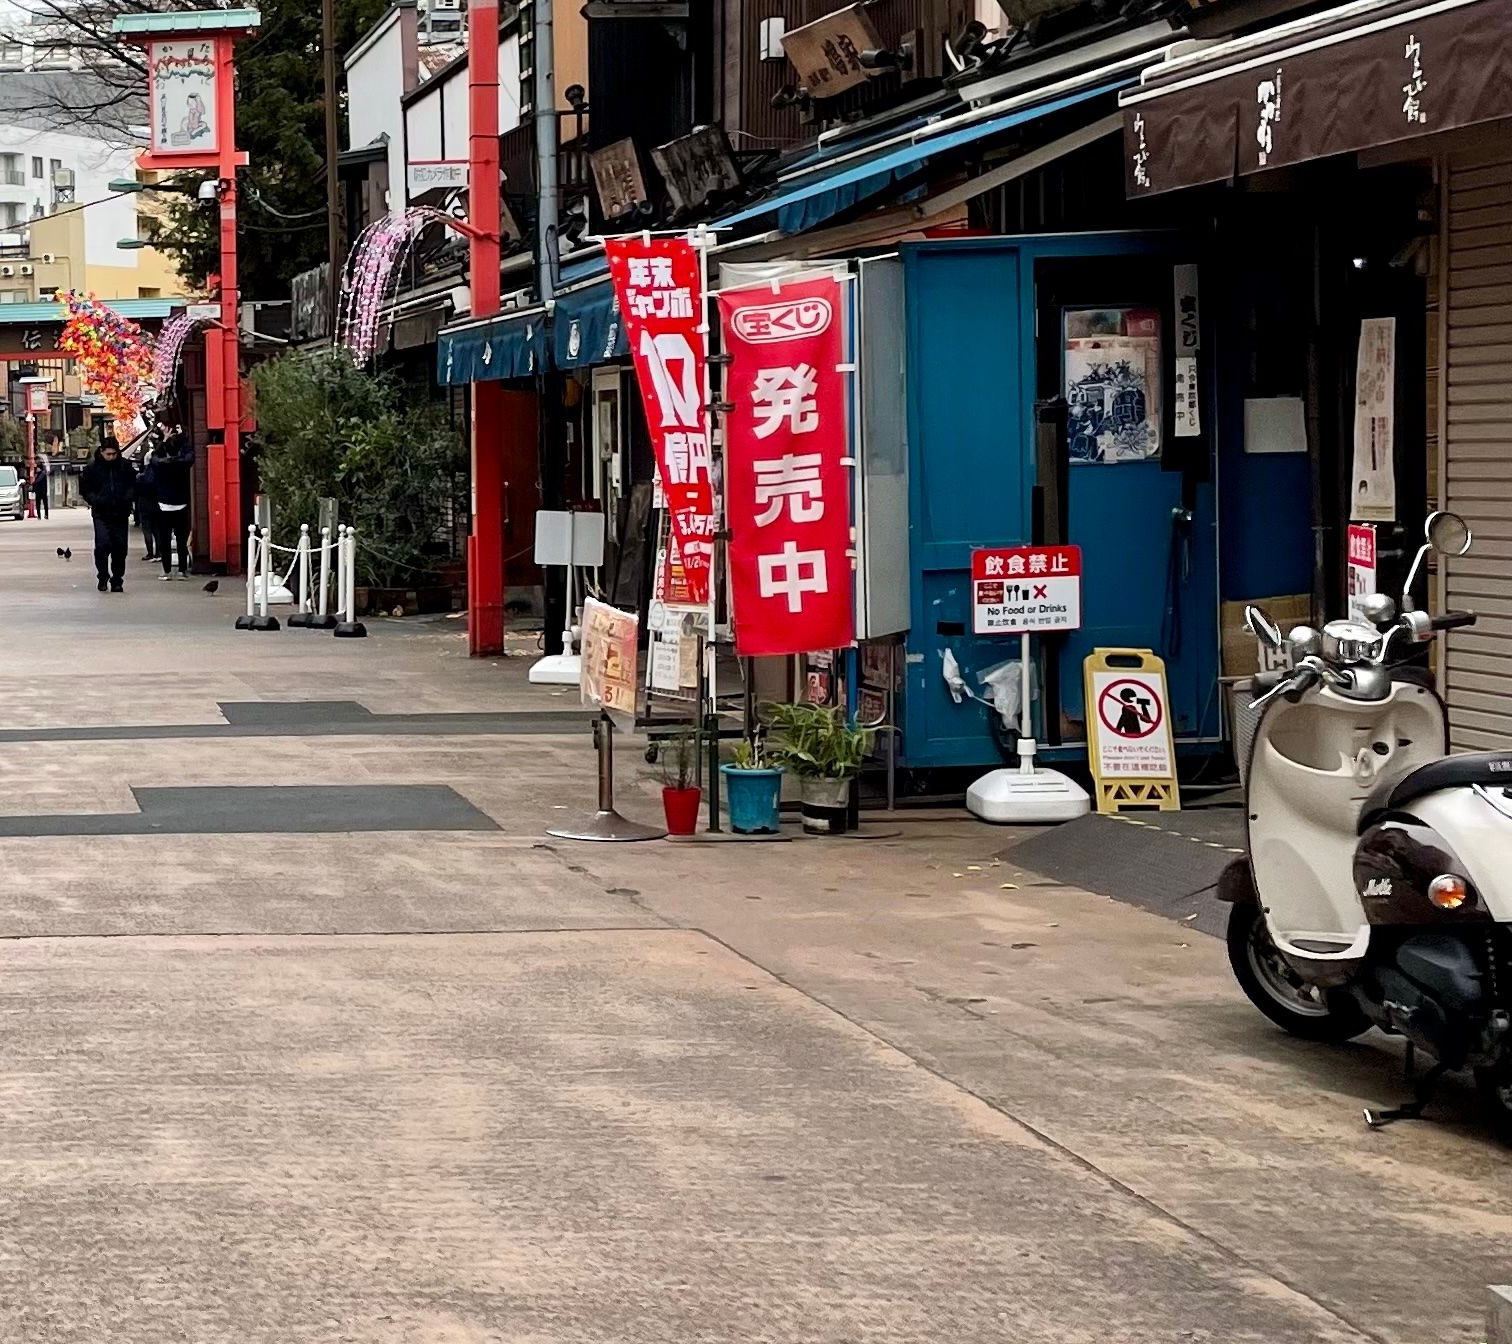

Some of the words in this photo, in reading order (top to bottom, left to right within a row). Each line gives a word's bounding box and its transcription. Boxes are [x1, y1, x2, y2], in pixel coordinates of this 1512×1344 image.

[742, 304, 821, 338] 宝くじ
[750, 362, 829, 614] 発売中
[984, 552, 1070, 576] 飲食禁止
[988, 607, 1000, 616] No
[1003, 605, 1025, 615] Food
[1027, 606, 1037, 614] or
[1039, 604, 1067, 614] Drinks
